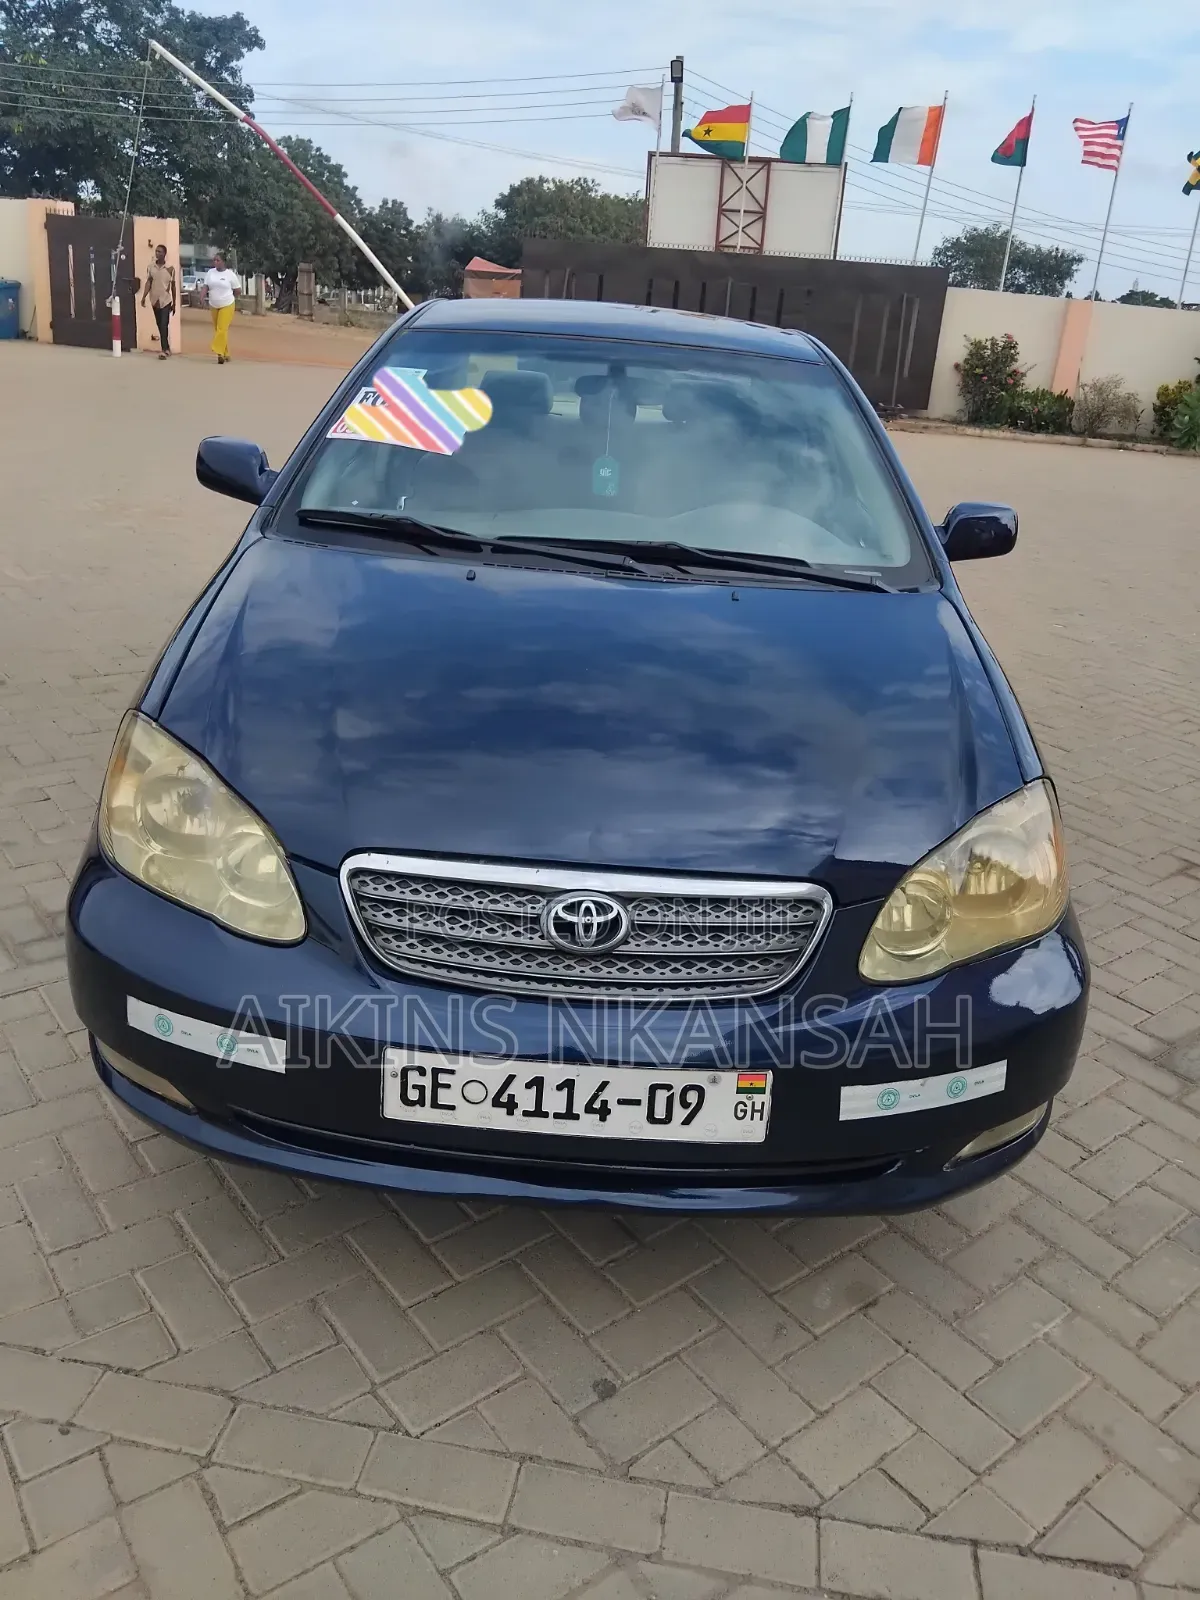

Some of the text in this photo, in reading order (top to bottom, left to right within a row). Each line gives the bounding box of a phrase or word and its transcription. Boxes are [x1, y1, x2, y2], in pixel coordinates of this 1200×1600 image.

[400, 1065, 706, 1126] GE 4114-09
[733, 1101, 766, 1121] GH
